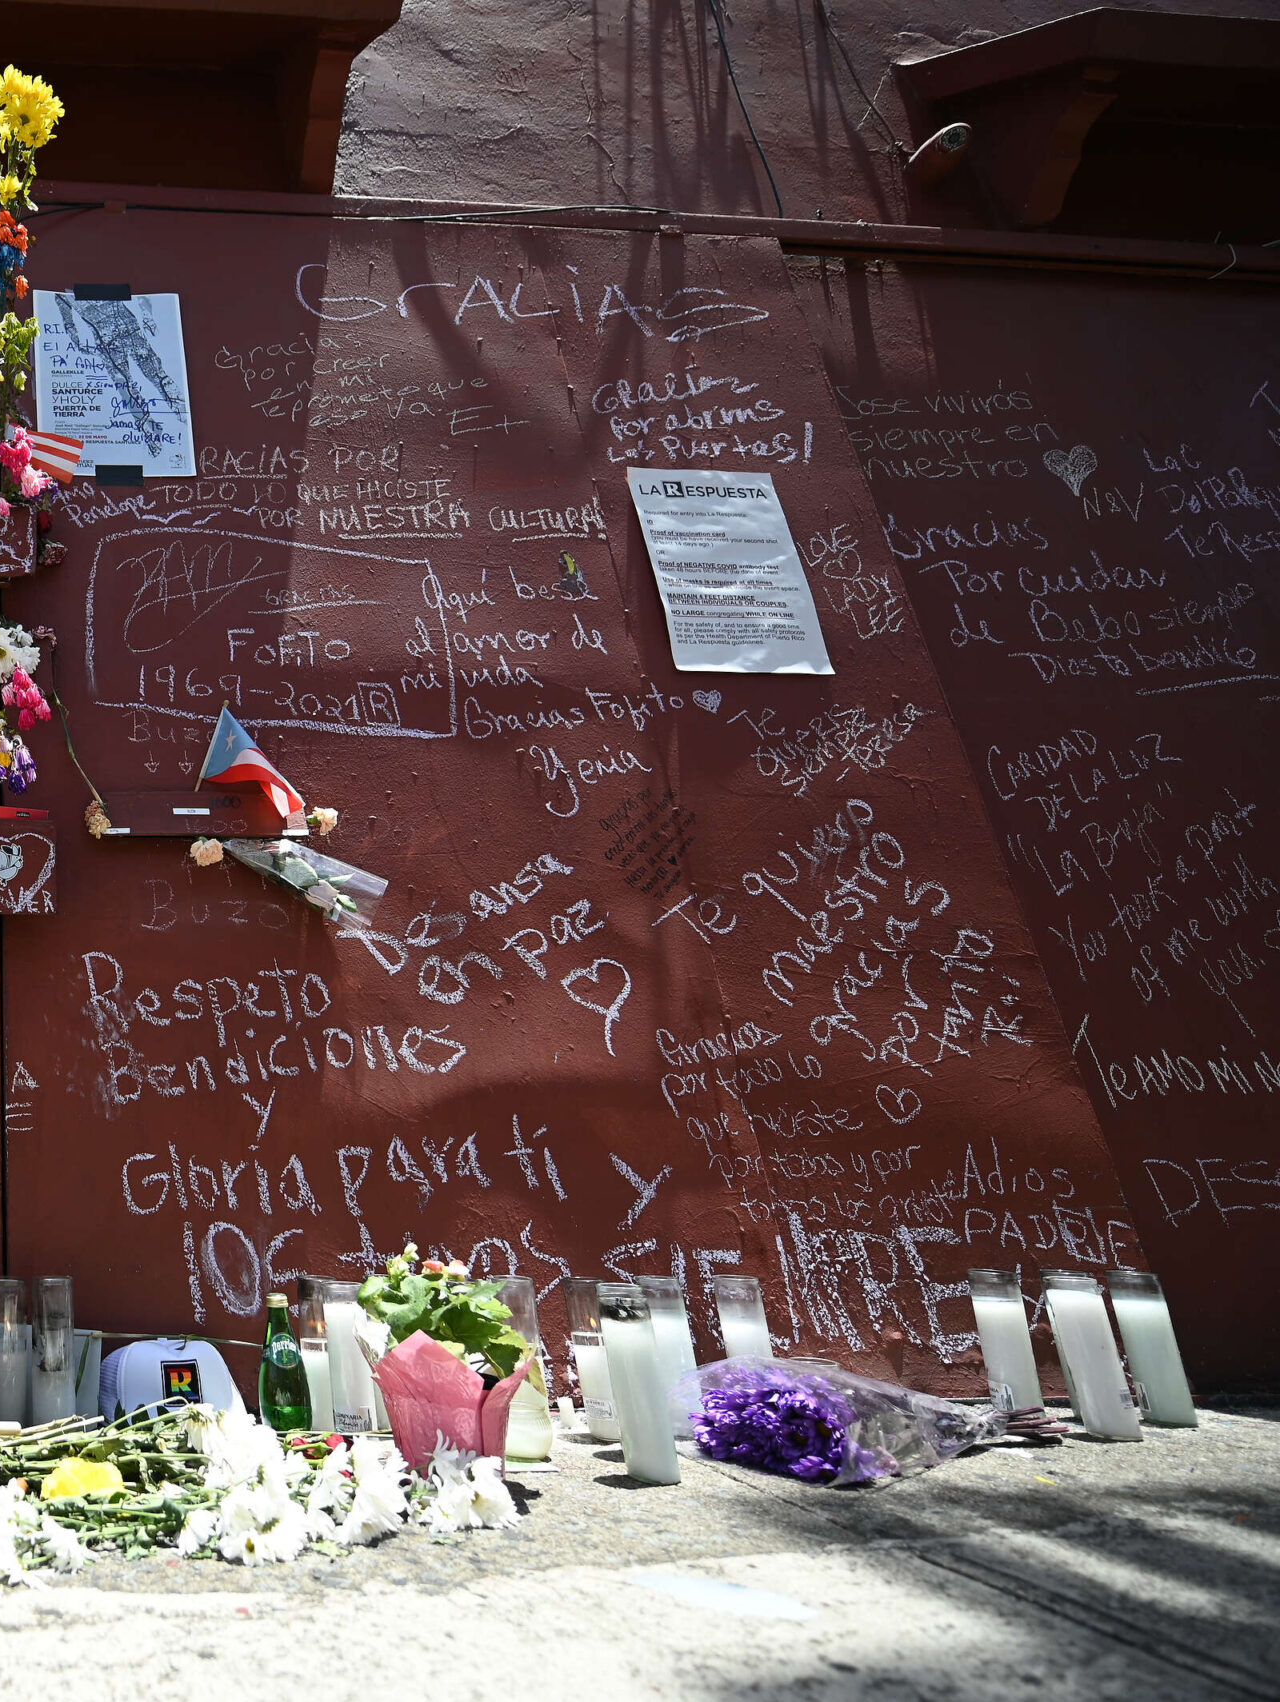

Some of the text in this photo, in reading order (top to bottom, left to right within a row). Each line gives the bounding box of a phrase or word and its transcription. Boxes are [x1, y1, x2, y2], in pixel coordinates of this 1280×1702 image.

[428, 376, 488, 400] que
[328, 444, 401, 473] POR
[851, 422, 1061, 452] siempre en
[863, 454, 1029, 481] nuestro
[297, 481, 348, 505] QUE
[639, 481, 767, 499] LA RESPUESTA
[257, 499, 472, 532] POR NUESTRA
[796, 523, 859, 567] LOVE
[571, 613, 607, 655] de
[844, 607, 906, 640] LEE
[950, 603, 1004, 647] de
[463, 697, 586, 740] Gracias
[987, 728, 1098, 800] CARIDAD
[651, 893, 737, 943] Te
[762, 831, 905, 1008] maestro
[420, 951, 504, 1005] en
[808, 874, 951, 1061] gracias
[82, 949, 331, 1049] Respeto
[656, 1021, 782, 1067] Gracias
[660, 1072, 707, 1118] por
[122, 1114, 568, 1218] Gloria para ti
[963, 1136, 1075, 1199] Adios
[166, 1367, 197, 1396] R
